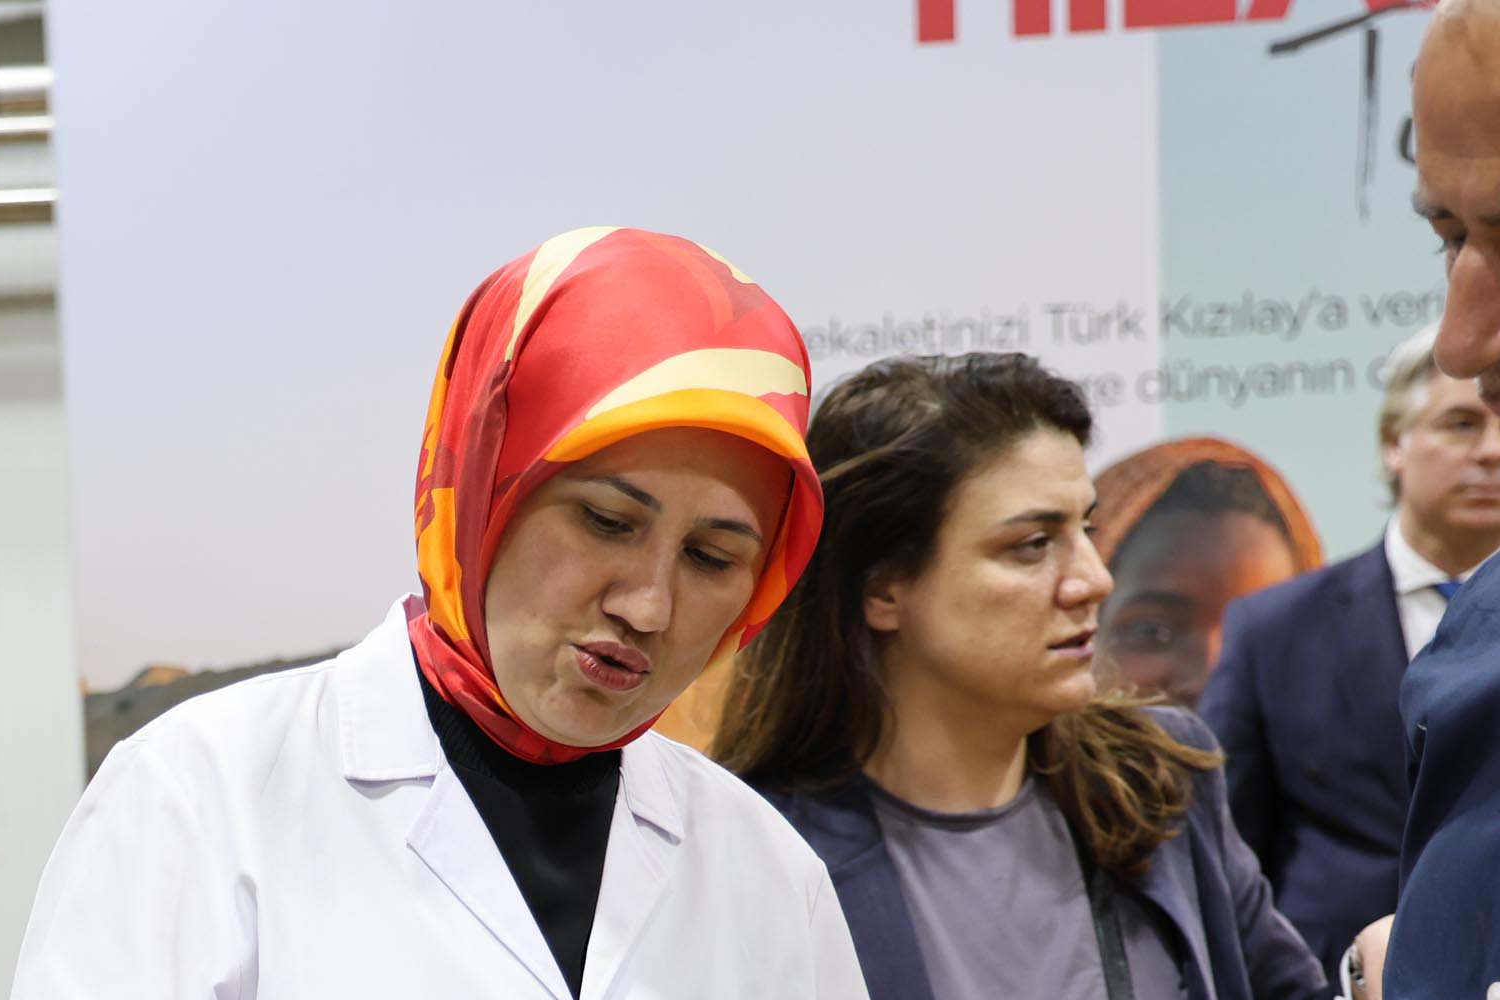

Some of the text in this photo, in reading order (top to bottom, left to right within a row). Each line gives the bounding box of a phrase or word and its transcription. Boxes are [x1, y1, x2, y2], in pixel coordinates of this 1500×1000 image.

[802, 305, 1030, 360] ekaletinizi
[1041, 300, 1147, 346] Türk
[1134, 358, 1356, 406] dünyanın
